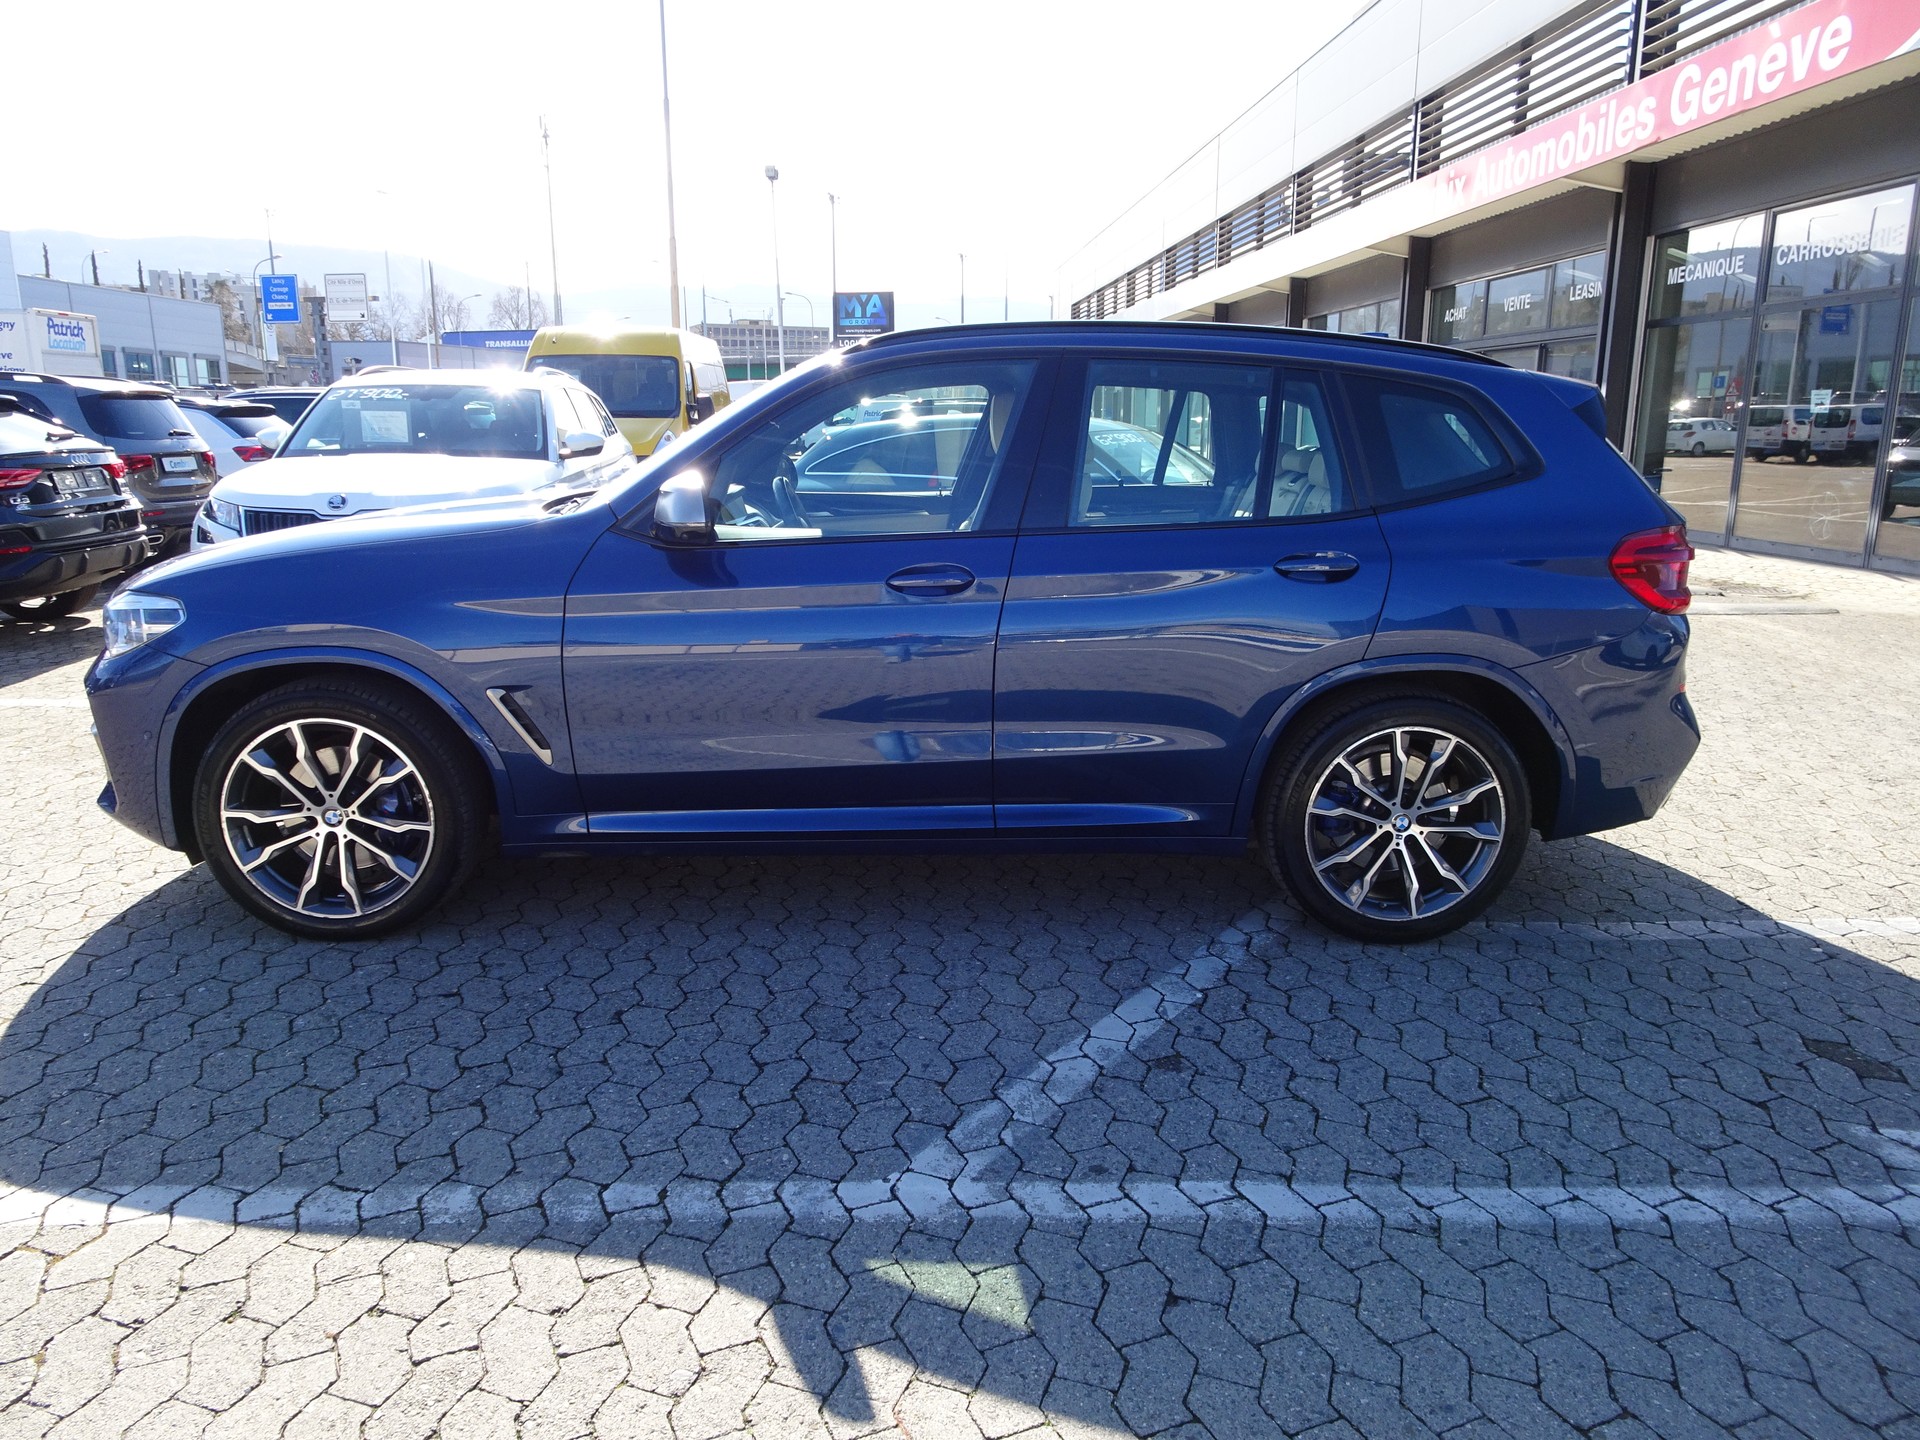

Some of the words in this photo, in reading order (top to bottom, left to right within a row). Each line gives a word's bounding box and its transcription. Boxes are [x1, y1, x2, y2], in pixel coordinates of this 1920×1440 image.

[1472, 95, 1657, 201] Automobiles
[1669, 14, 1853, 127] Genève
[1776, 223, 1906, 266] CARROSSERIE
[1667, 254, 1745, 286] MECANIQUE
[839, 294, 887, 318] MYA
[1444, 306, 1467, 323] ACHAT
[1504, 293, 1532, 313] VENTE
[47, 316, 86, 341] Patrick
[48, 335, 86, 351] Location
